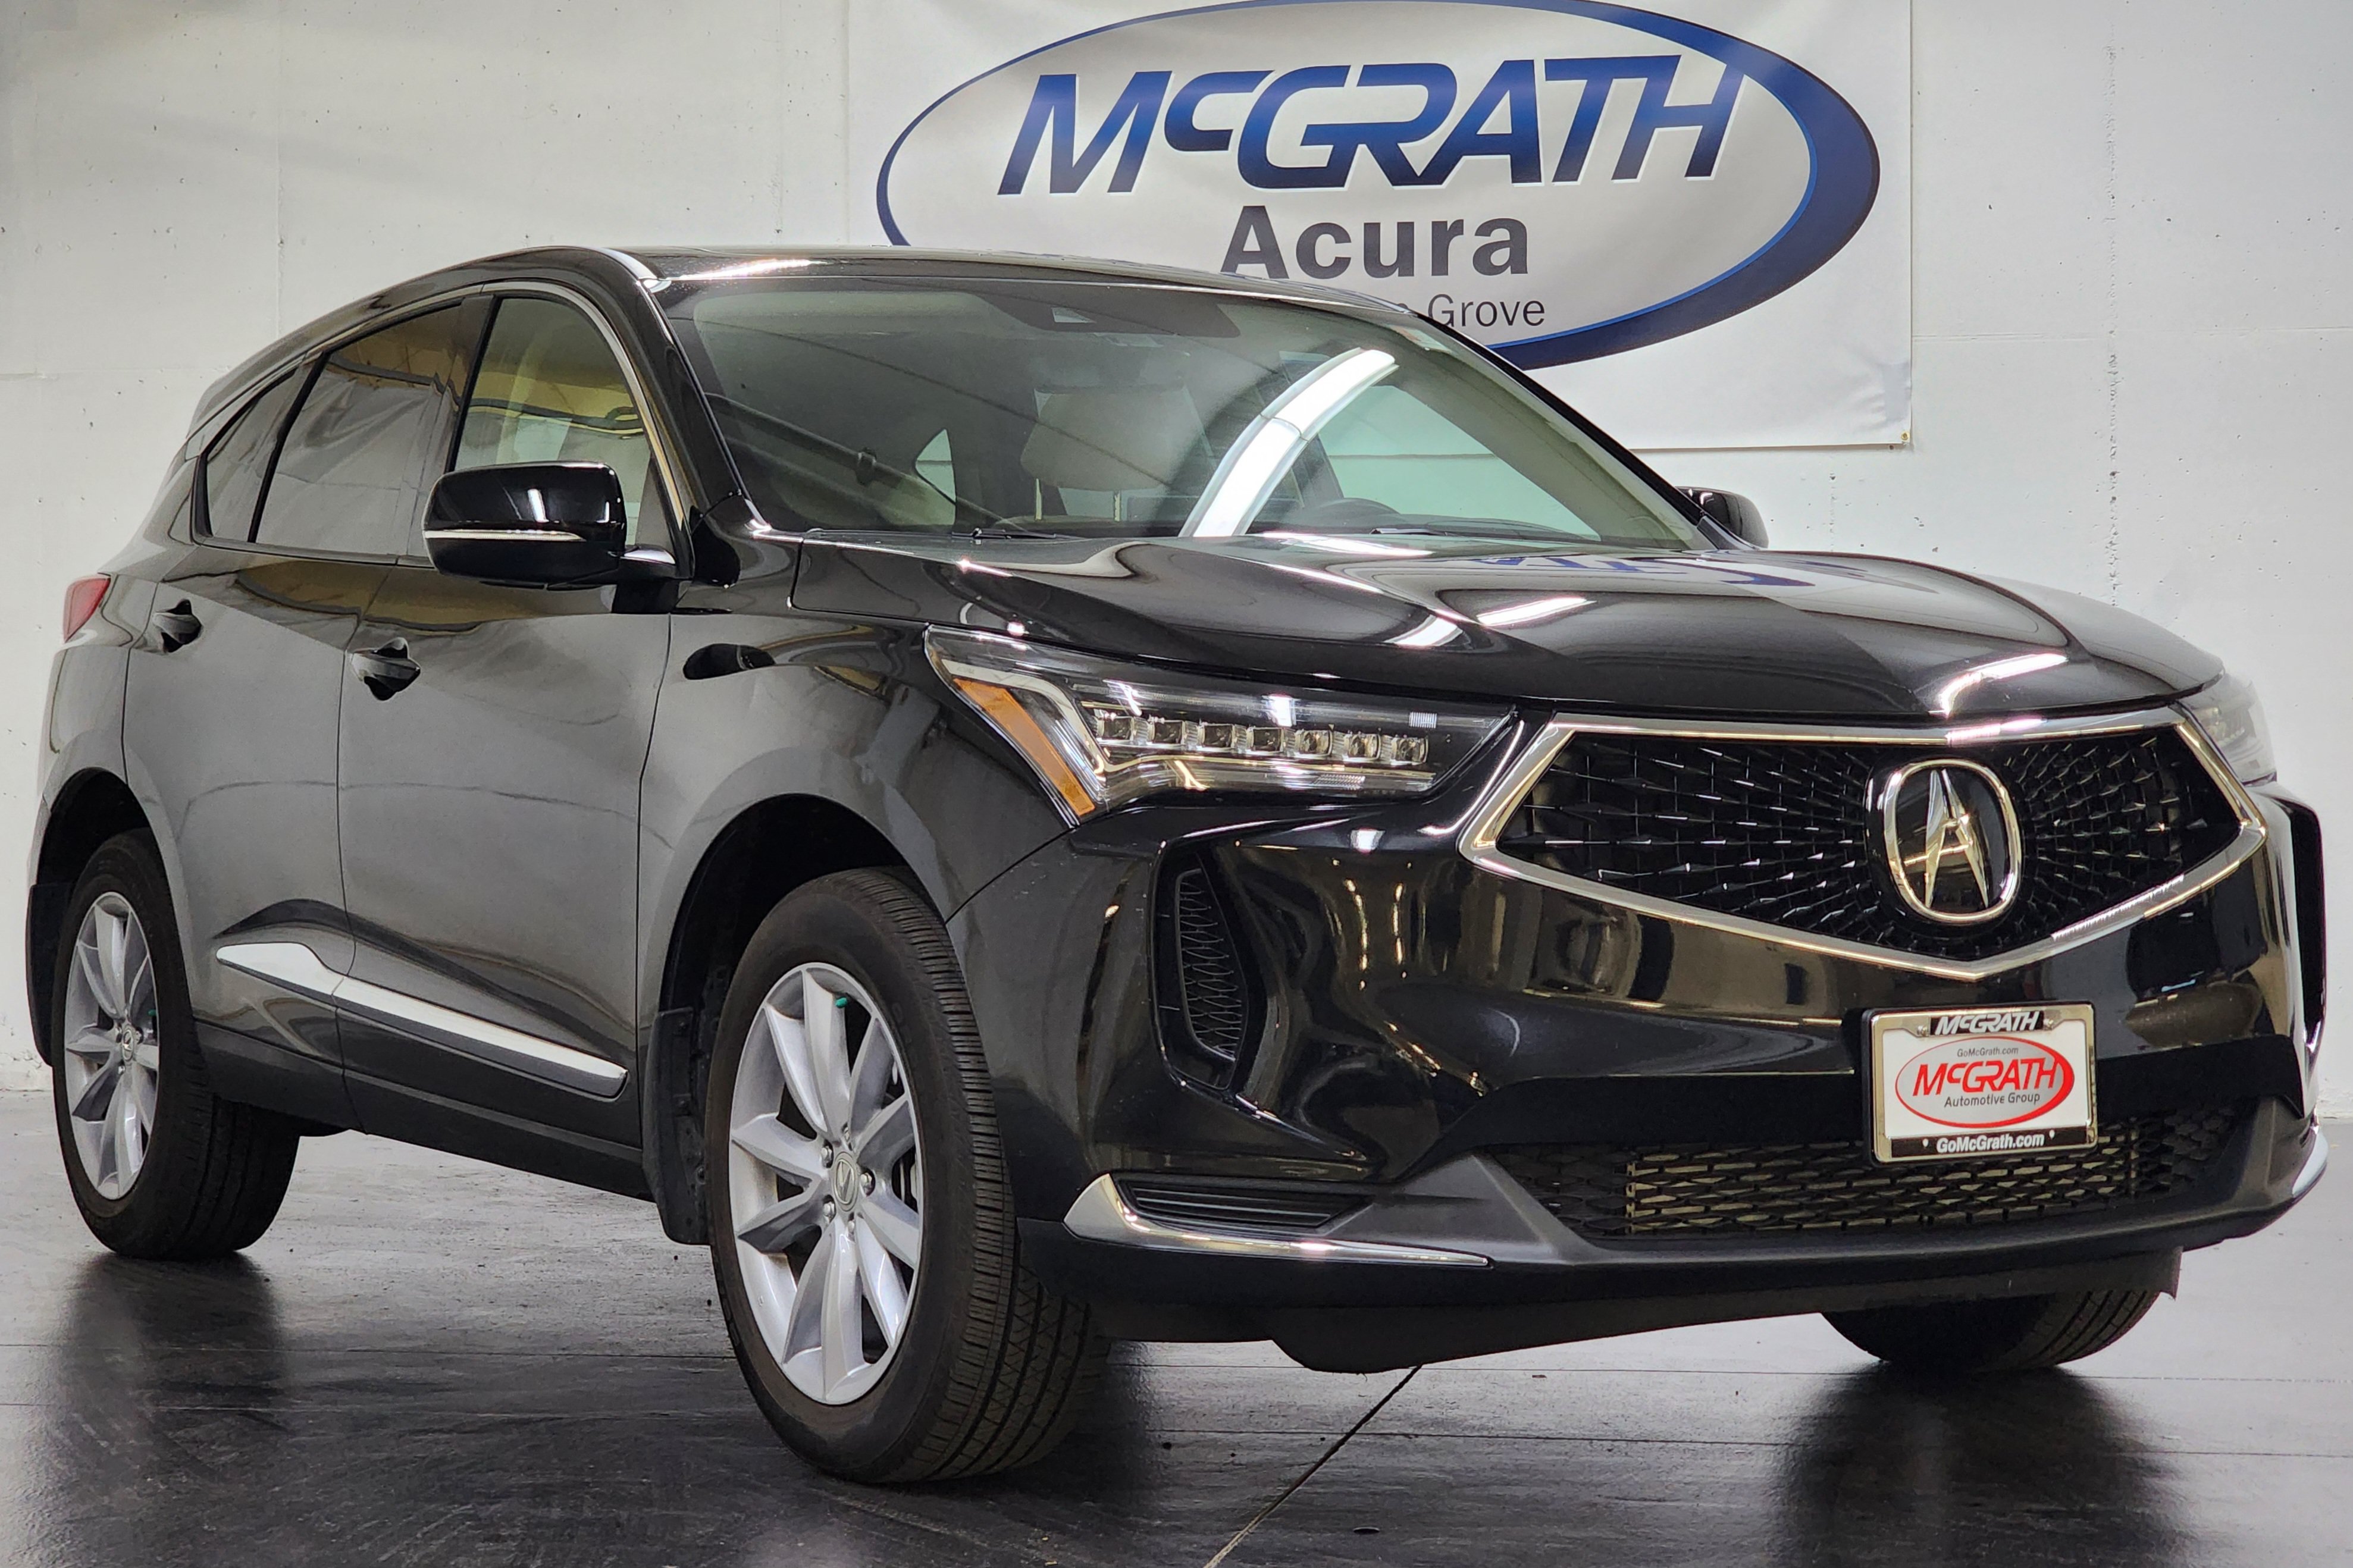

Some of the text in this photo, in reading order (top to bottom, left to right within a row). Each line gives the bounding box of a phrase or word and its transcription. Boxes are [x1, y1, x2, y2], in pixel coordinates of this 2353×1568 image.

[1221, 206, 1529, 279] Acura
[1429, 294, 1545, 327] Grove
[1957, 1047, 2019, 1057] GoMcGrath.com
[1944, 1092, 2041, 1108] Automotive Group
[1937, 1134, 2045, 1153] GoMcGrath.com
